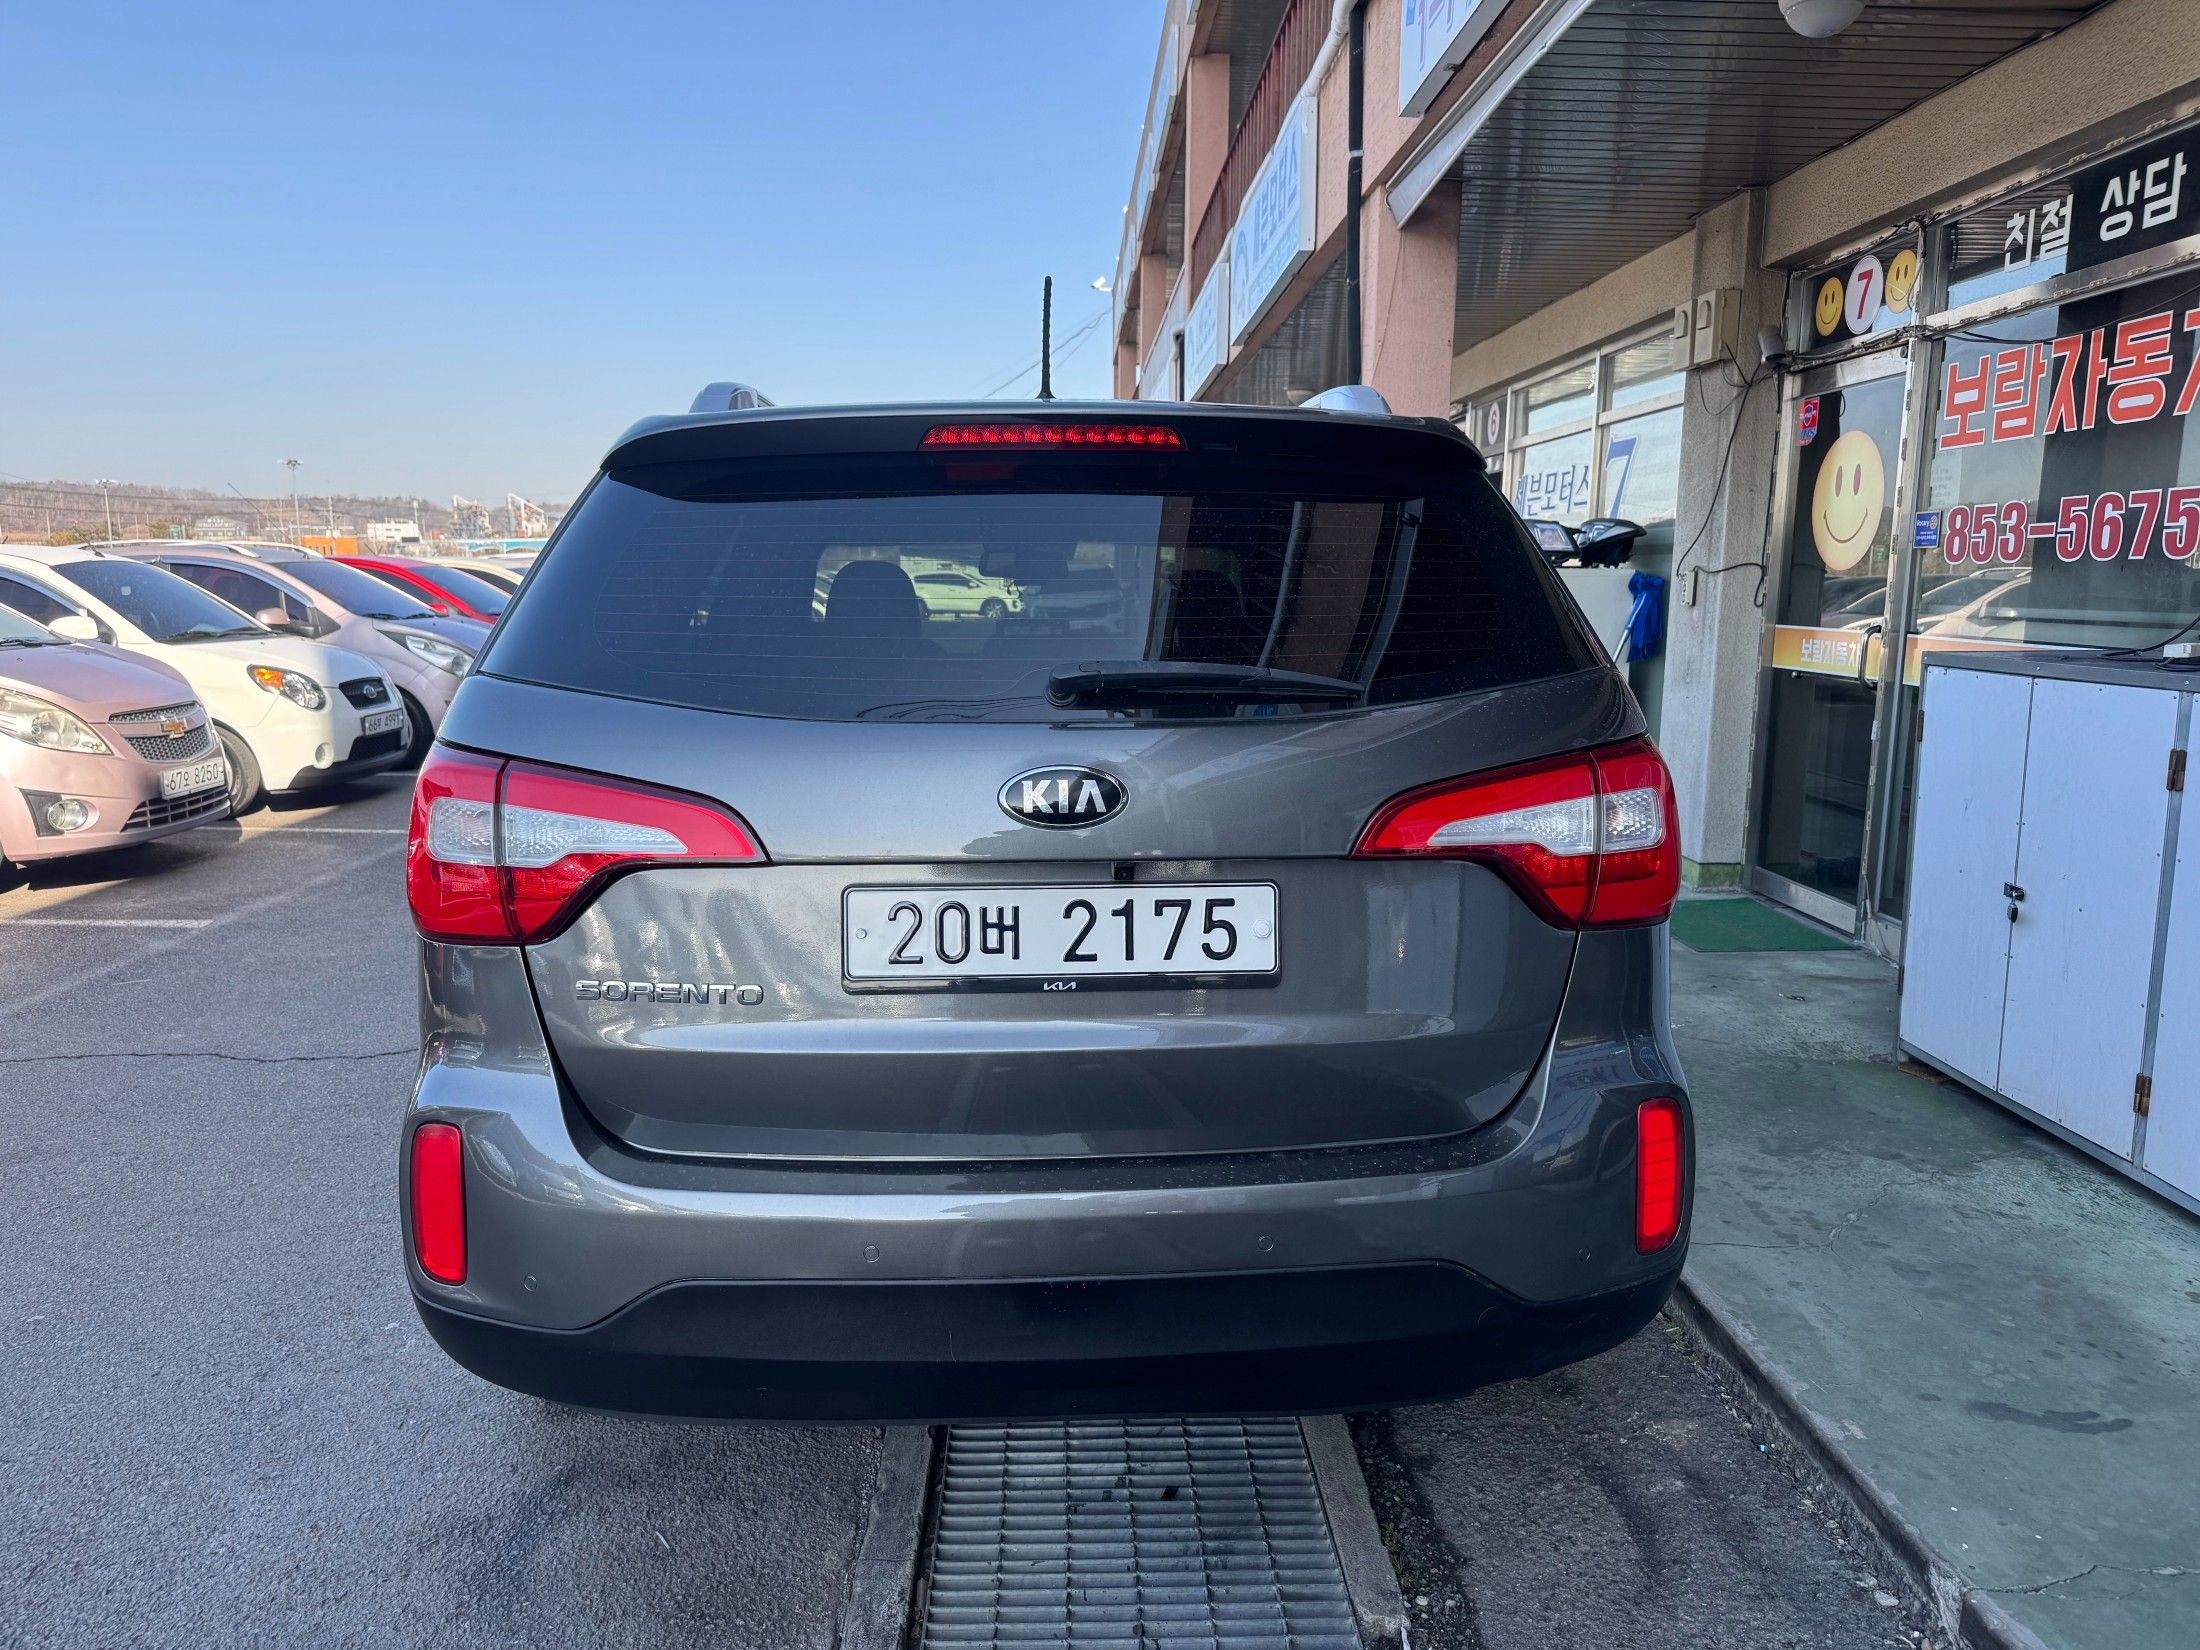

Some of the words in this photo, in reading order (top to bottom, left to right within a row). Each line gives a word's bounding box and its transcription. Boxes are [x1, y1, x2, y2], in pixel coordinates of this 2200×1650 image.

[2004, 193, 2074, 272] 친절
[2099, 151, 2188, 242] 상담
[1857, 268, 1874, 320] 7
[1943, 486, 2200, 565] 853-5675
[194, 763, 219, 784] 8250
[1021, 779, 1108, 814] KIA
[887, 900, 1021, 965] 20버
[1062, 897, 1238, 962] 2175
[575, 979, 764, 1006] SORENTO
